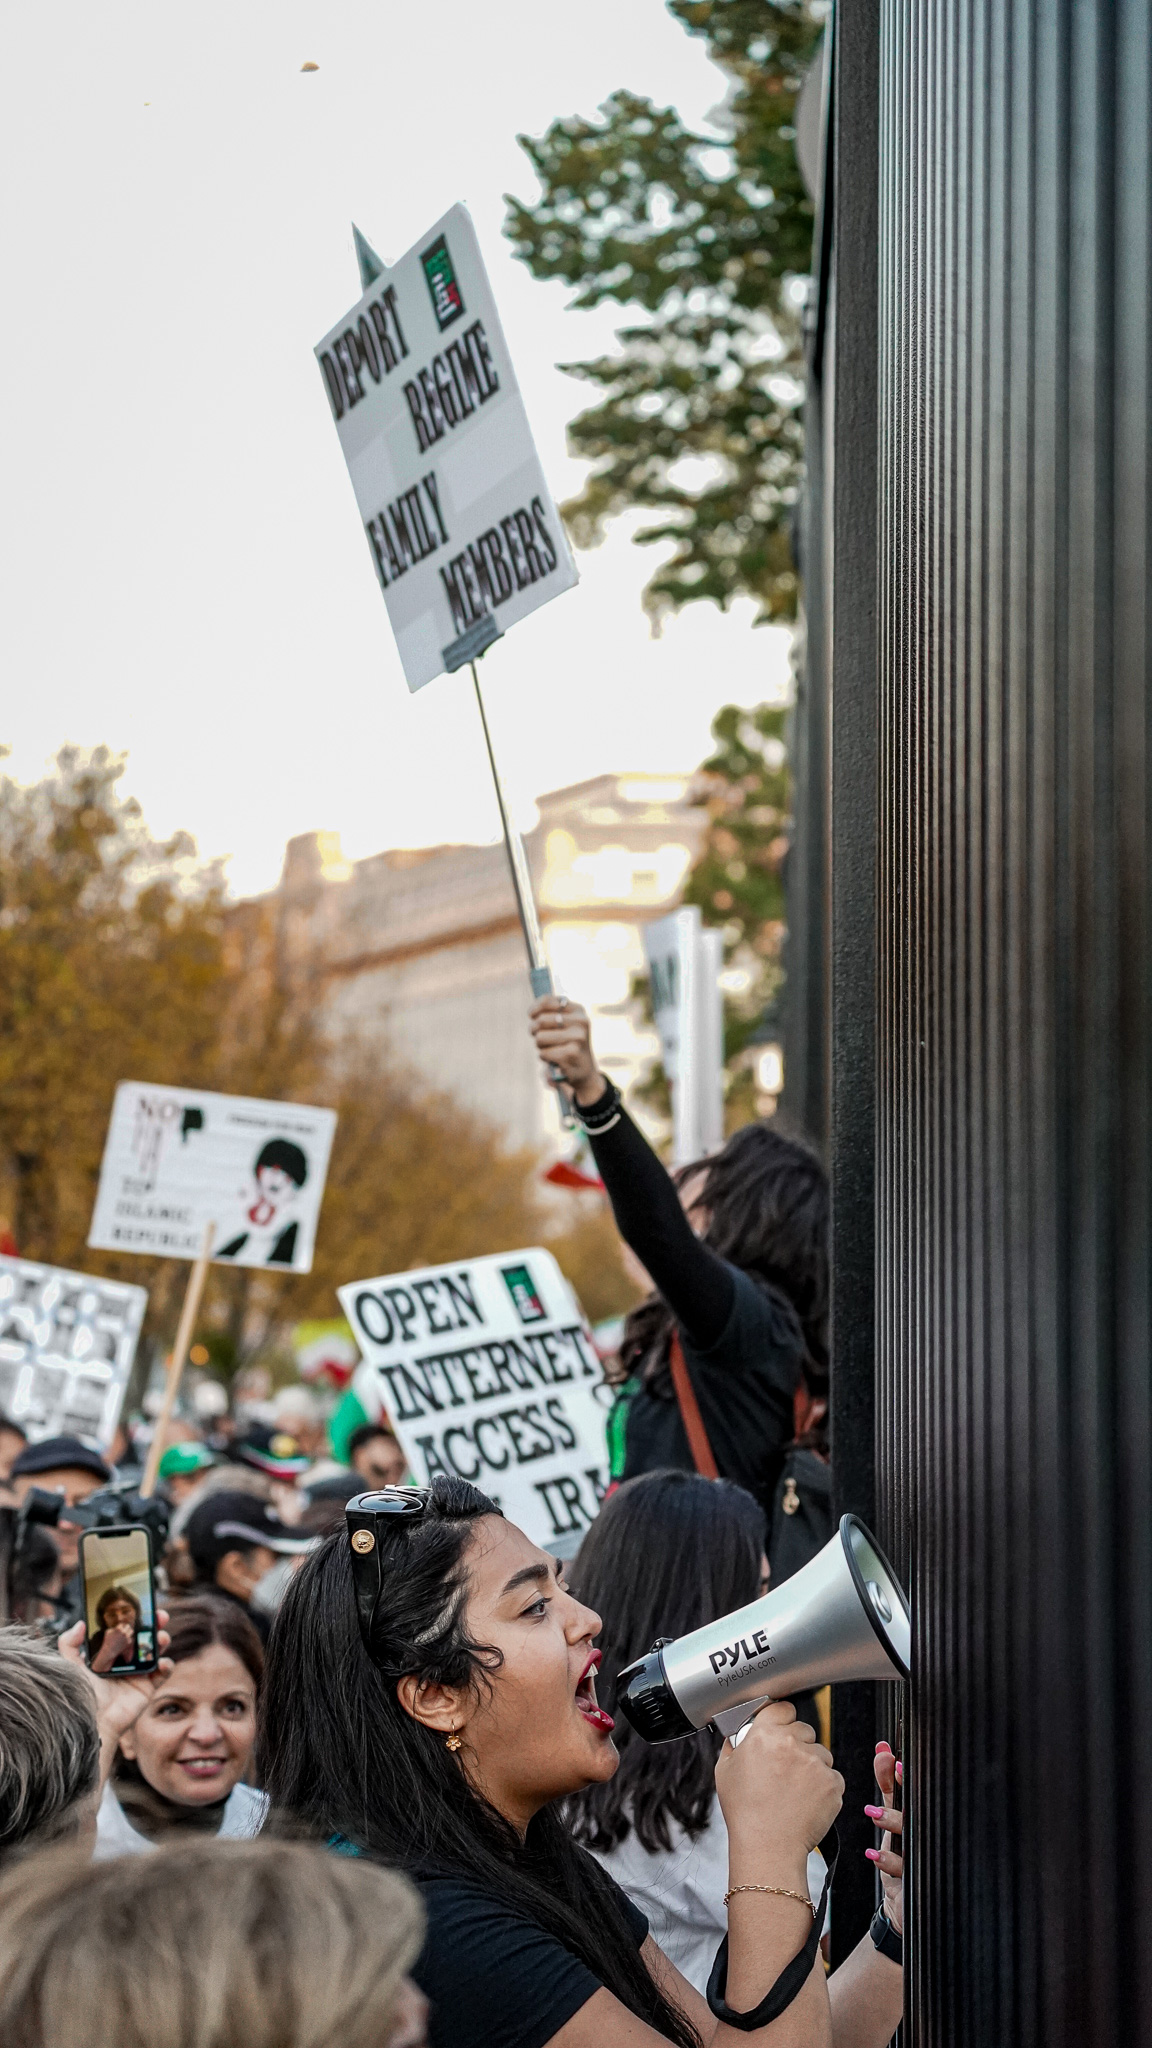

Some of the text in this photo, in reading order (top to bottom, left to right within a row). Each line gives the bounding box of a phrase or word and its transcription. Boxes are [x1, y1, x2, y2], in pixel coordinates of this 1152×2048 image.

[319, 283, 411, 422] DEPORT
[402, 318, 501, 455] REGIME
[366, 471, 450, 589] FAMILY
[439, 494, 558, 637] MEMBERS
[354, 1272, 485, 1346] OPEN
[378, 1325, 595, 1421] INTERNET
[415, 1398, 577, 1482] ACCESS
[708, 1629, 771, 1675] PYLE
